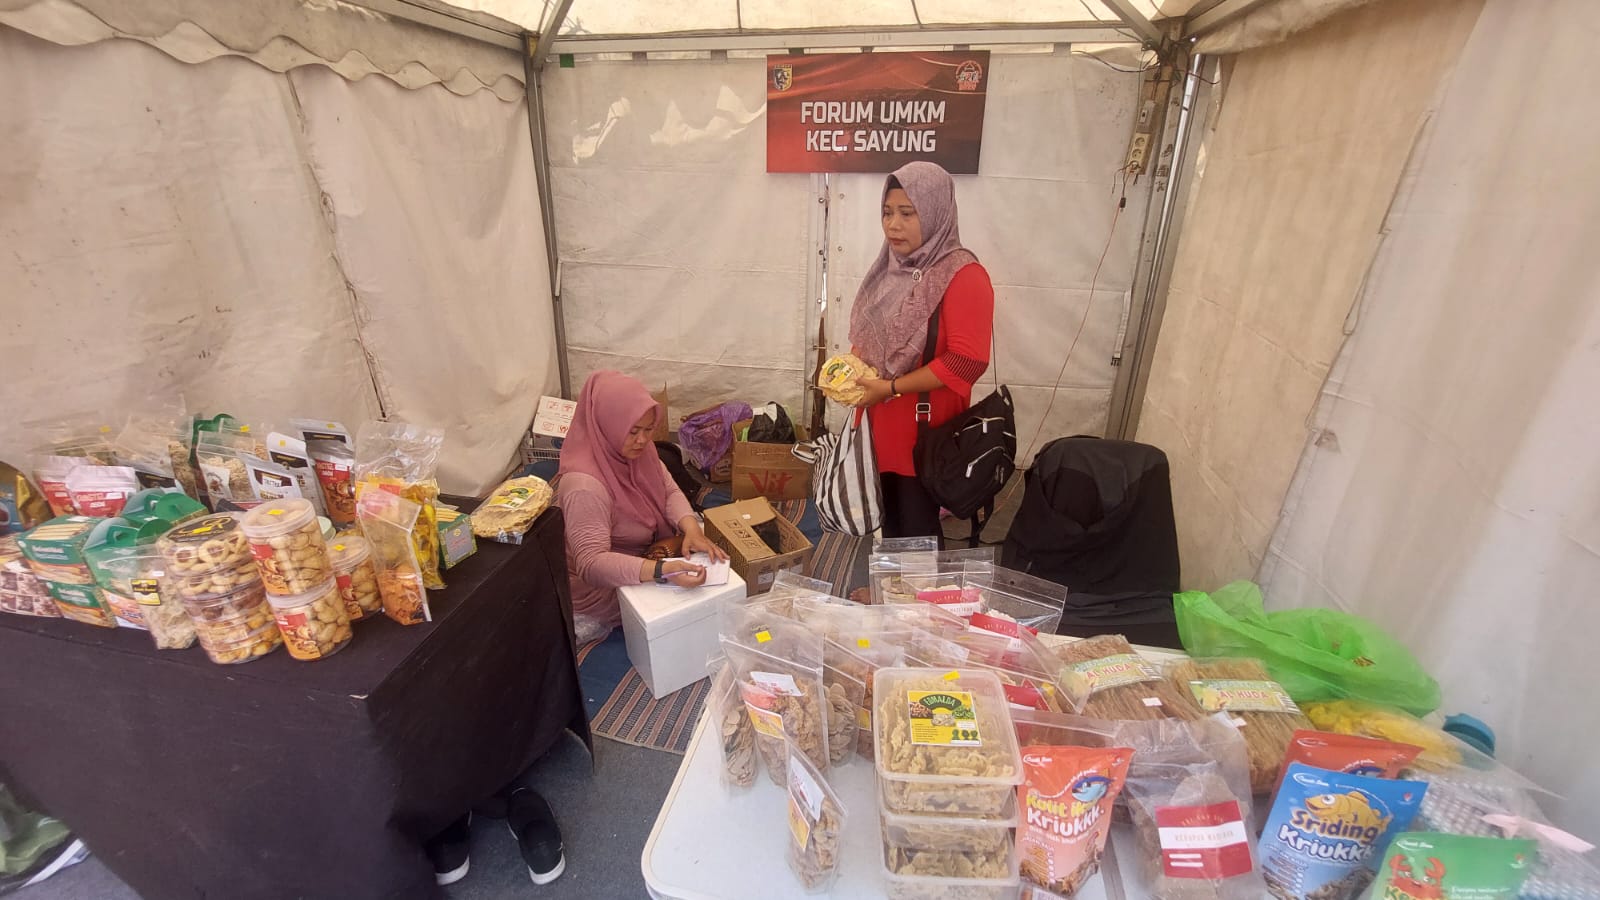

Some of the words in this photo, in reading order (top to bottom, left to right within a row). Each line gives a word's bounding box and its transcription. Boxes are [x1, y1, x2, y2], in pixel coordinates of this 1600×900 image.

[801, 101, 873, 124] FORUM
[880, 101, 946, 124] UMKM
[806, 130, 848, 152] KEC.
[854, 130, 936, 152] SAYUNG
[1291, 808, 1379, 846] Sriding
